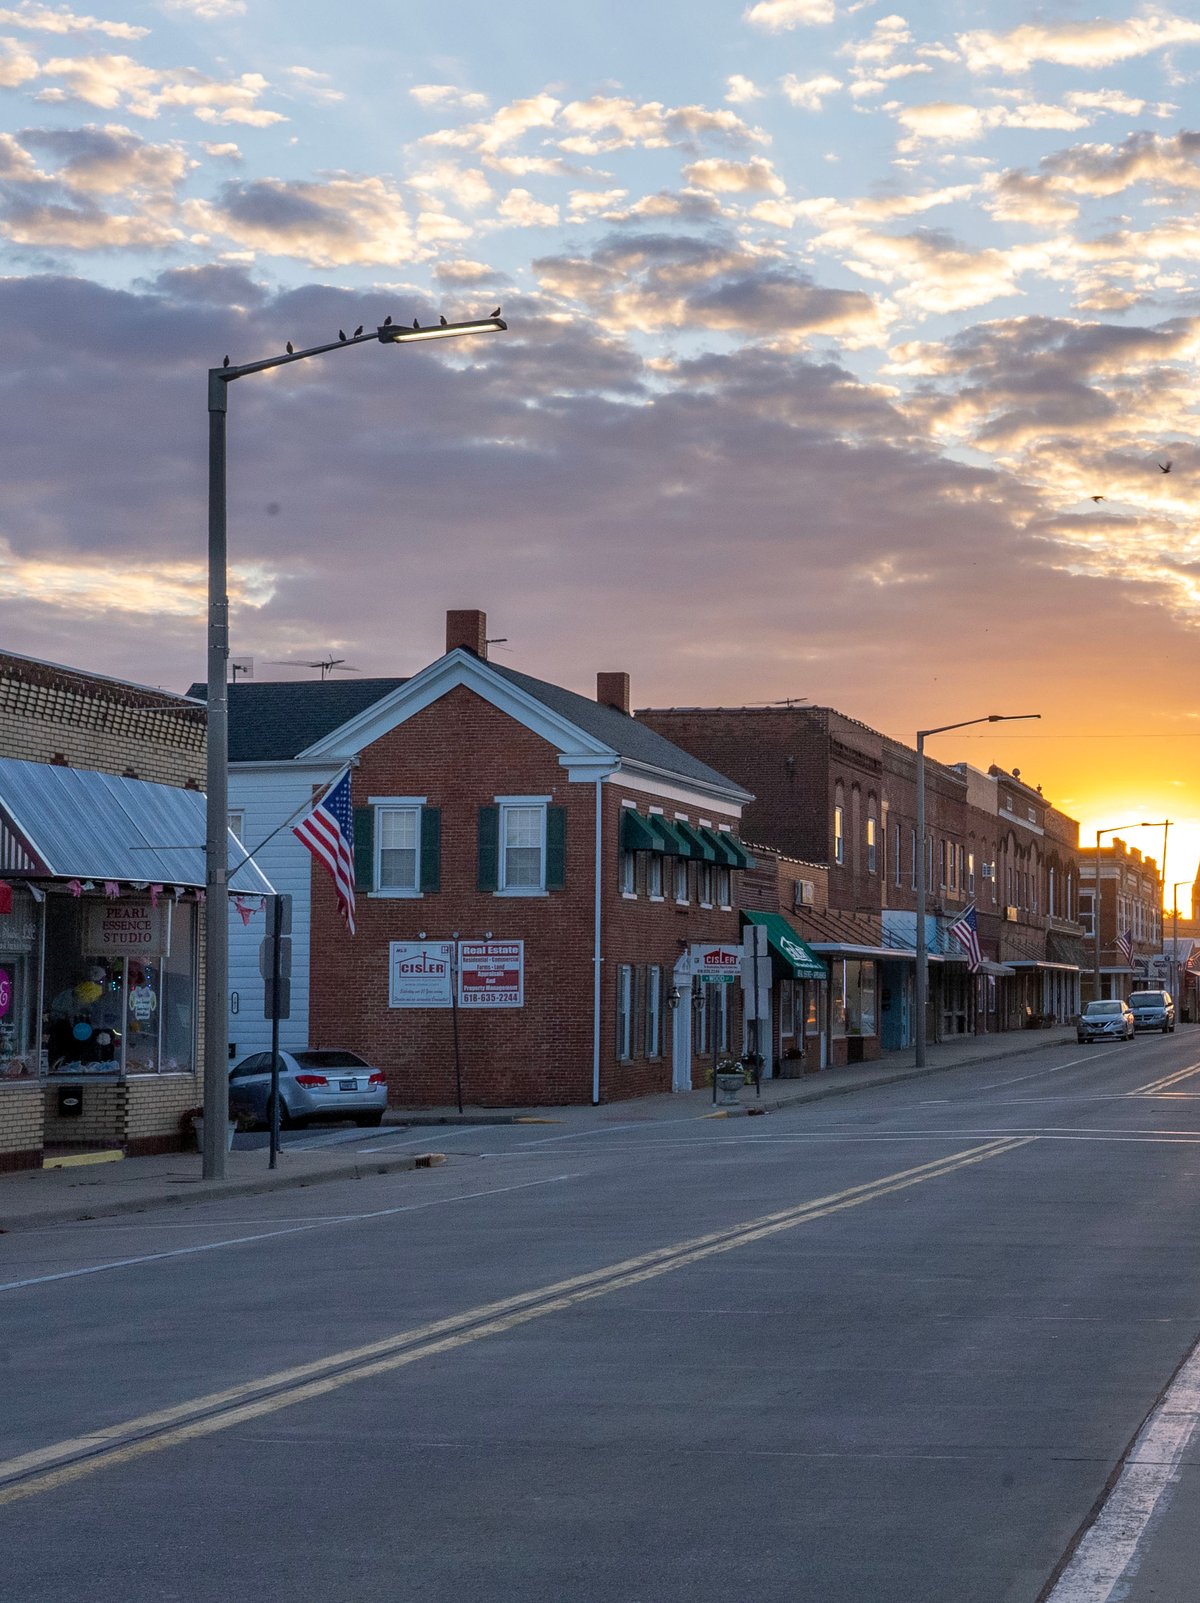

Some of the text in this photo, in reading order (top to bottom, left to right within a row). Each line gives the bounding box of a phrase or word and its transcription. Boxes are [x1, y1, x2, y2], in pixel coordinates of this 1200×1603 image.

[107, 908, 148, 918] PEARL
[103, 921, 151, 930] ESSENCE
[103, 933, 152, 942] STUDIO
[706, 950, 735, 964] CISLER
[401, 952, 444, 973] CISLER
[464, 993, 518, 1001] 618-635-2244
